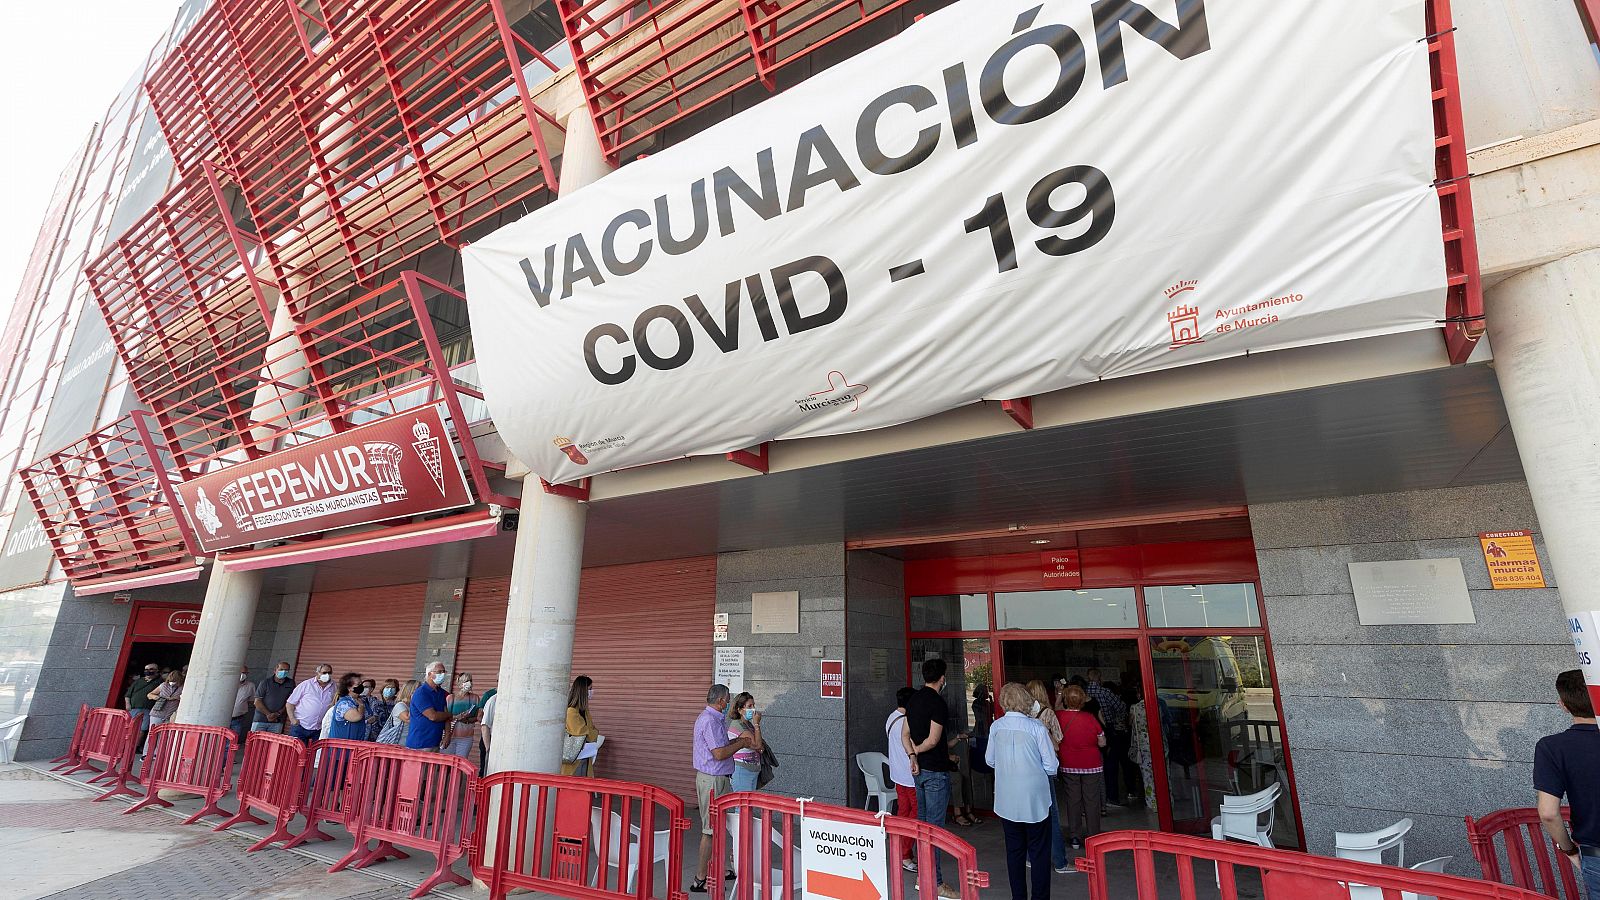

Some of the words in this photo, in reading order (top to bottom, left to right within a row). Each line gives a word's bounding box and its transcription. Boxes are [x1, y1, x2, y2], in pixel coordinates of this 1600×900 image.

[519, 0, 1211, 308] VACUNACIÓN
[583, 255, 848, 385] COVID
[889, 258, 925, 283] -
[964, 164, 1116, 274] 19
[1215, 291, 1304, 319] Ayuntamiento
[1216, 323, 1231, 333] de
[1234, 314, 1279, 331] Murcia
[798, 394, 853, 412] Murciano
[237, 445, 374, 512] FEPEMUR
[254, 510, 292, 526] FEDERACIÓN
[292, 508, 302, 519] DE
[303, 503, 325, 516] PEÑAS
[325, 491, 379, 511] MURCIANISTAS
[1493, 566, 1535, 574] murcia
[809, 830, 874, 848] VACUNACIÓN
[816, 845, 846, 857] COVID
[856, 851, 867, 861] 19
